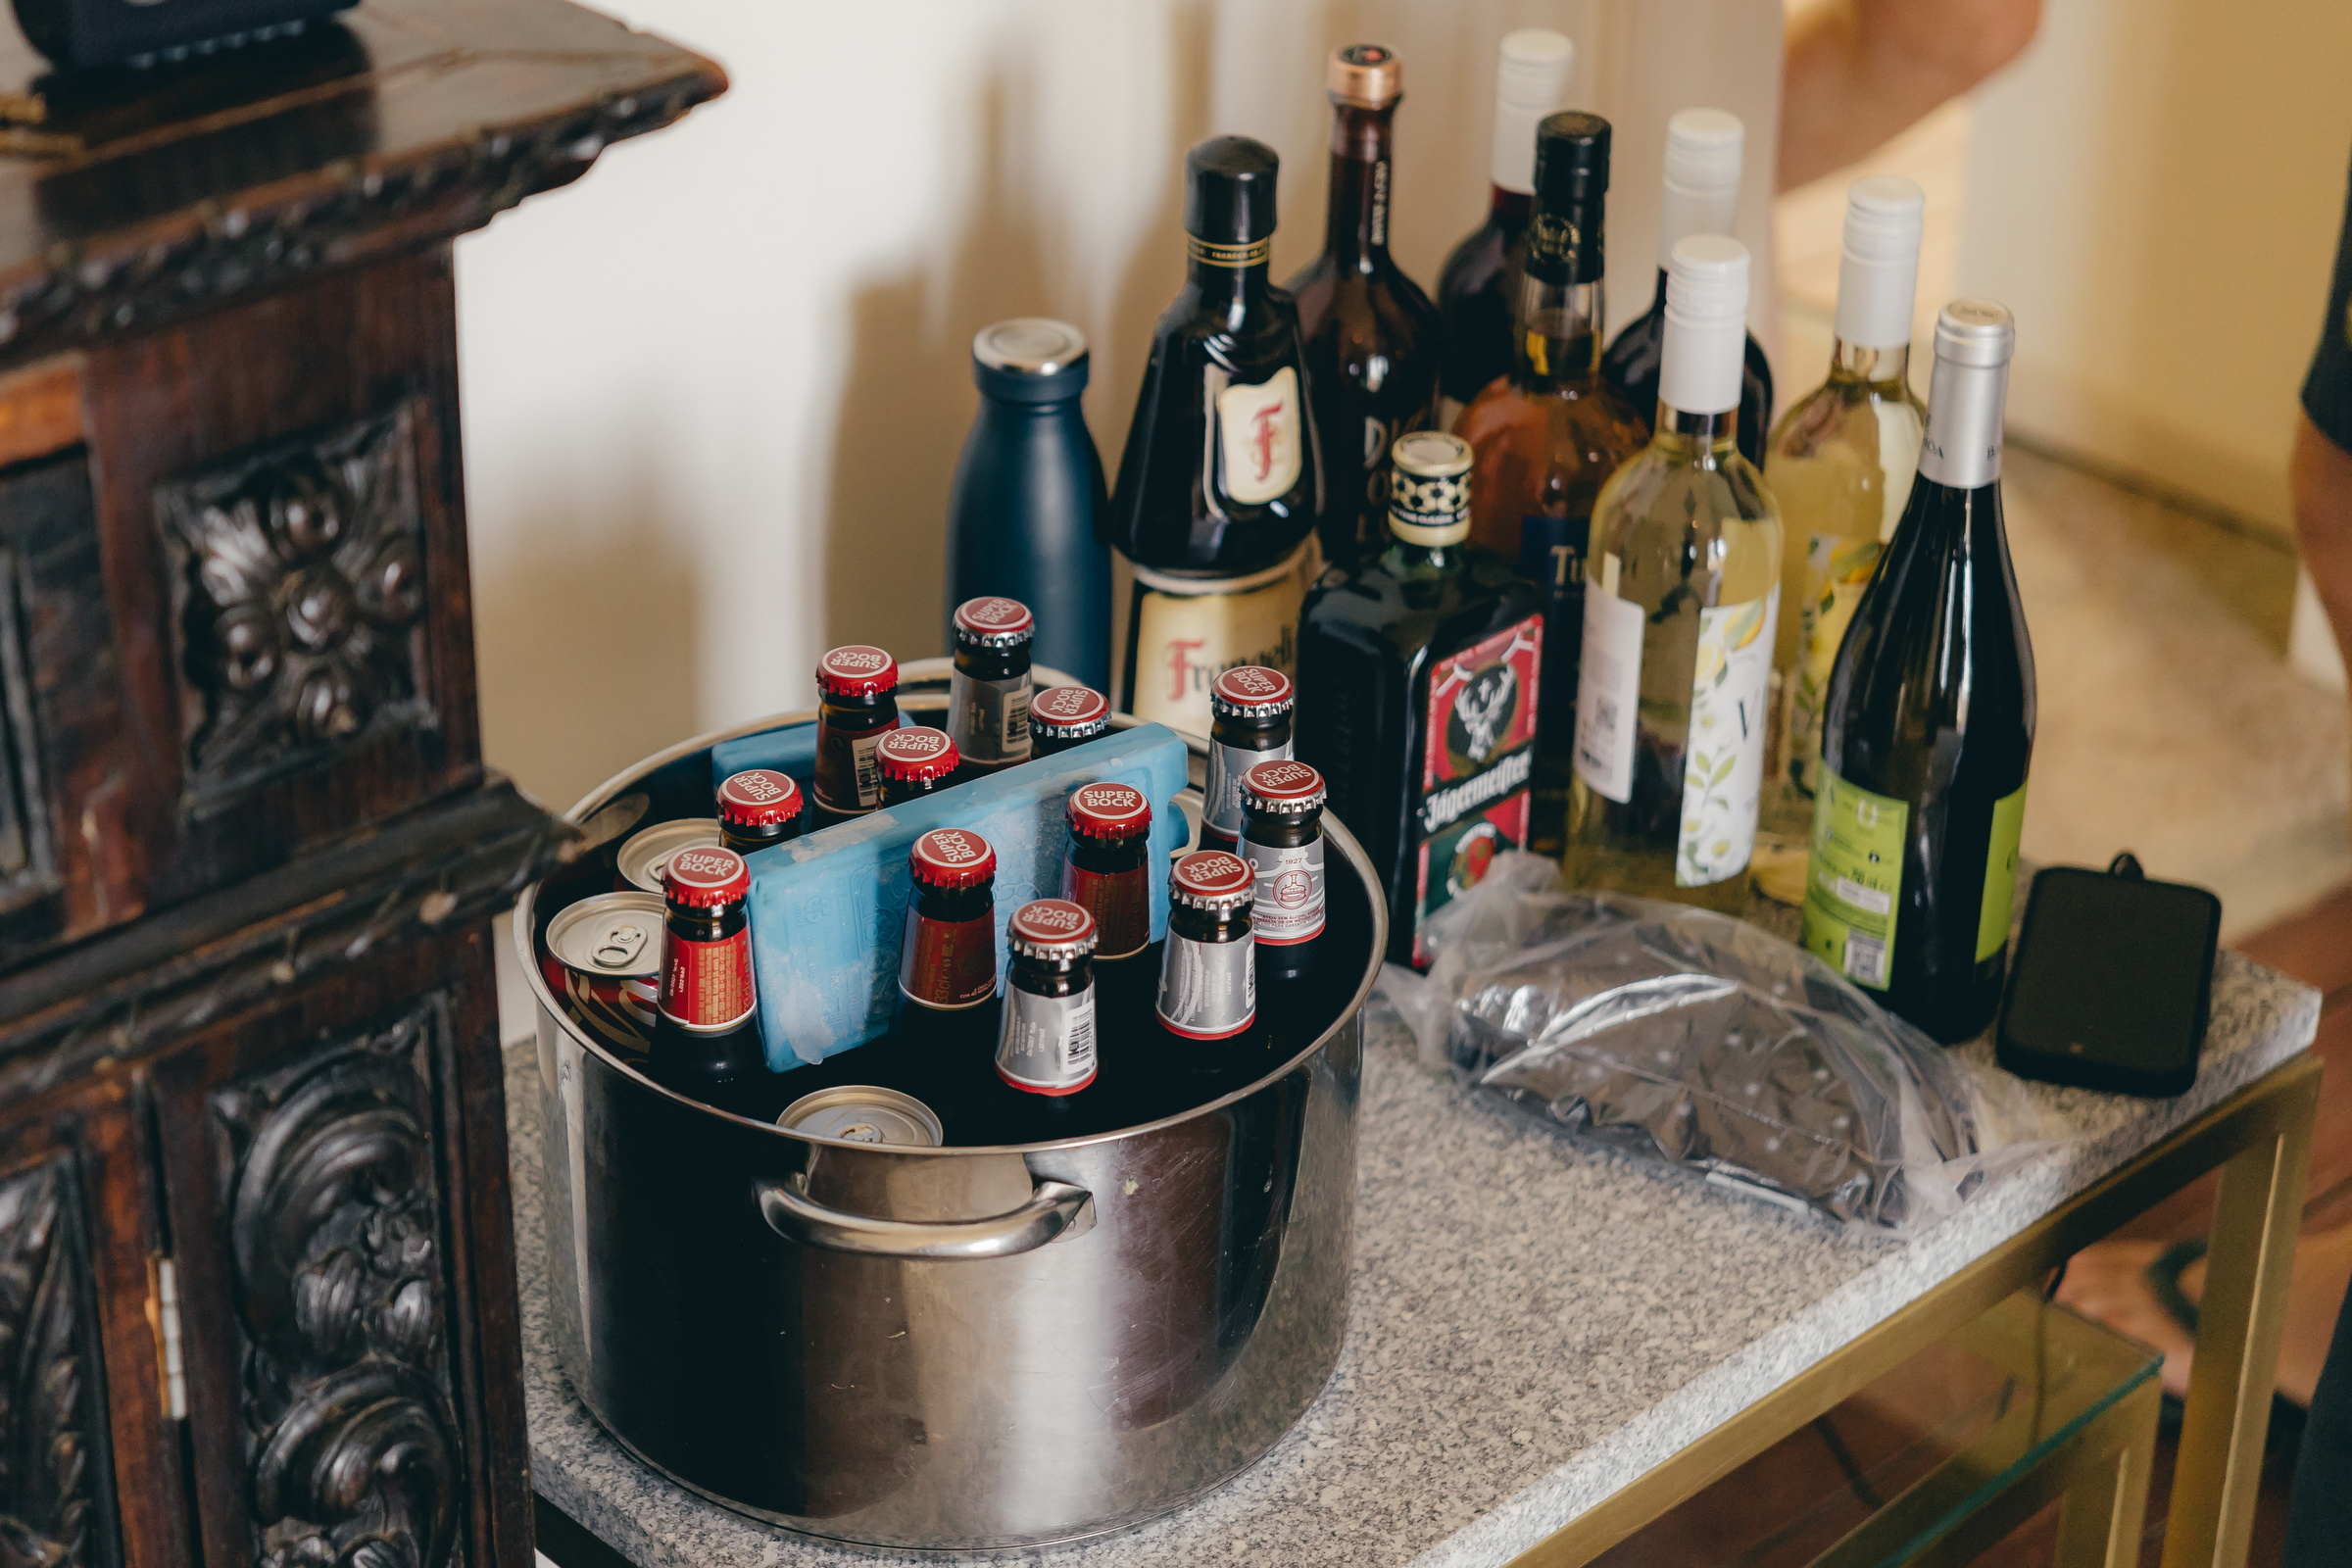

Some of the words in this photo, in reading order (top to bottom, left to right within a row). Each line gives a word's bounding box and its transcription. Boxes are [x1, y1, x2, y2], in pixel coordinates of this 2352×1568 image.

[972, 598, 1006, 620] SUPER
[985, 603, 1017, 623] BOCK
[830, 658, 881, 669] SUPER
[836, 652, 881, 662] BOCK
[1232, 671, 1263, 694] BOCK
[1244, 668, 1276, 692] SUPER
[1050, 689, 1074, 711] BOCK
[1062, 689, 1089, 714] SUPER
[887, 741, 940, 752] SUPER
[893, 733, 940, 744] BOCK
[1255, 763, 1301, 780] BOCK
[1262, 769, 1312, 787] SUPER
[733, 775, 771, 801] SUPER
[747, 772, 782, 796] BOCK
[1083, 790, 1137, 800] SUPER
[1087, 798, 1136, 808] BOCK
[931, 832, 962, 862] SUPER
[946, 831, 977, 858] BOCK
[678, 860, 728, 877] BOCK
[680, 853, 735, 869] SUPER
[1183, 856, 1233, 874] BOCK
[1189, 862, 1242, 882] SUPER
[1022, 912, 1078, 931] SUPER
[1029, 905, 1079, 922] BOCK
